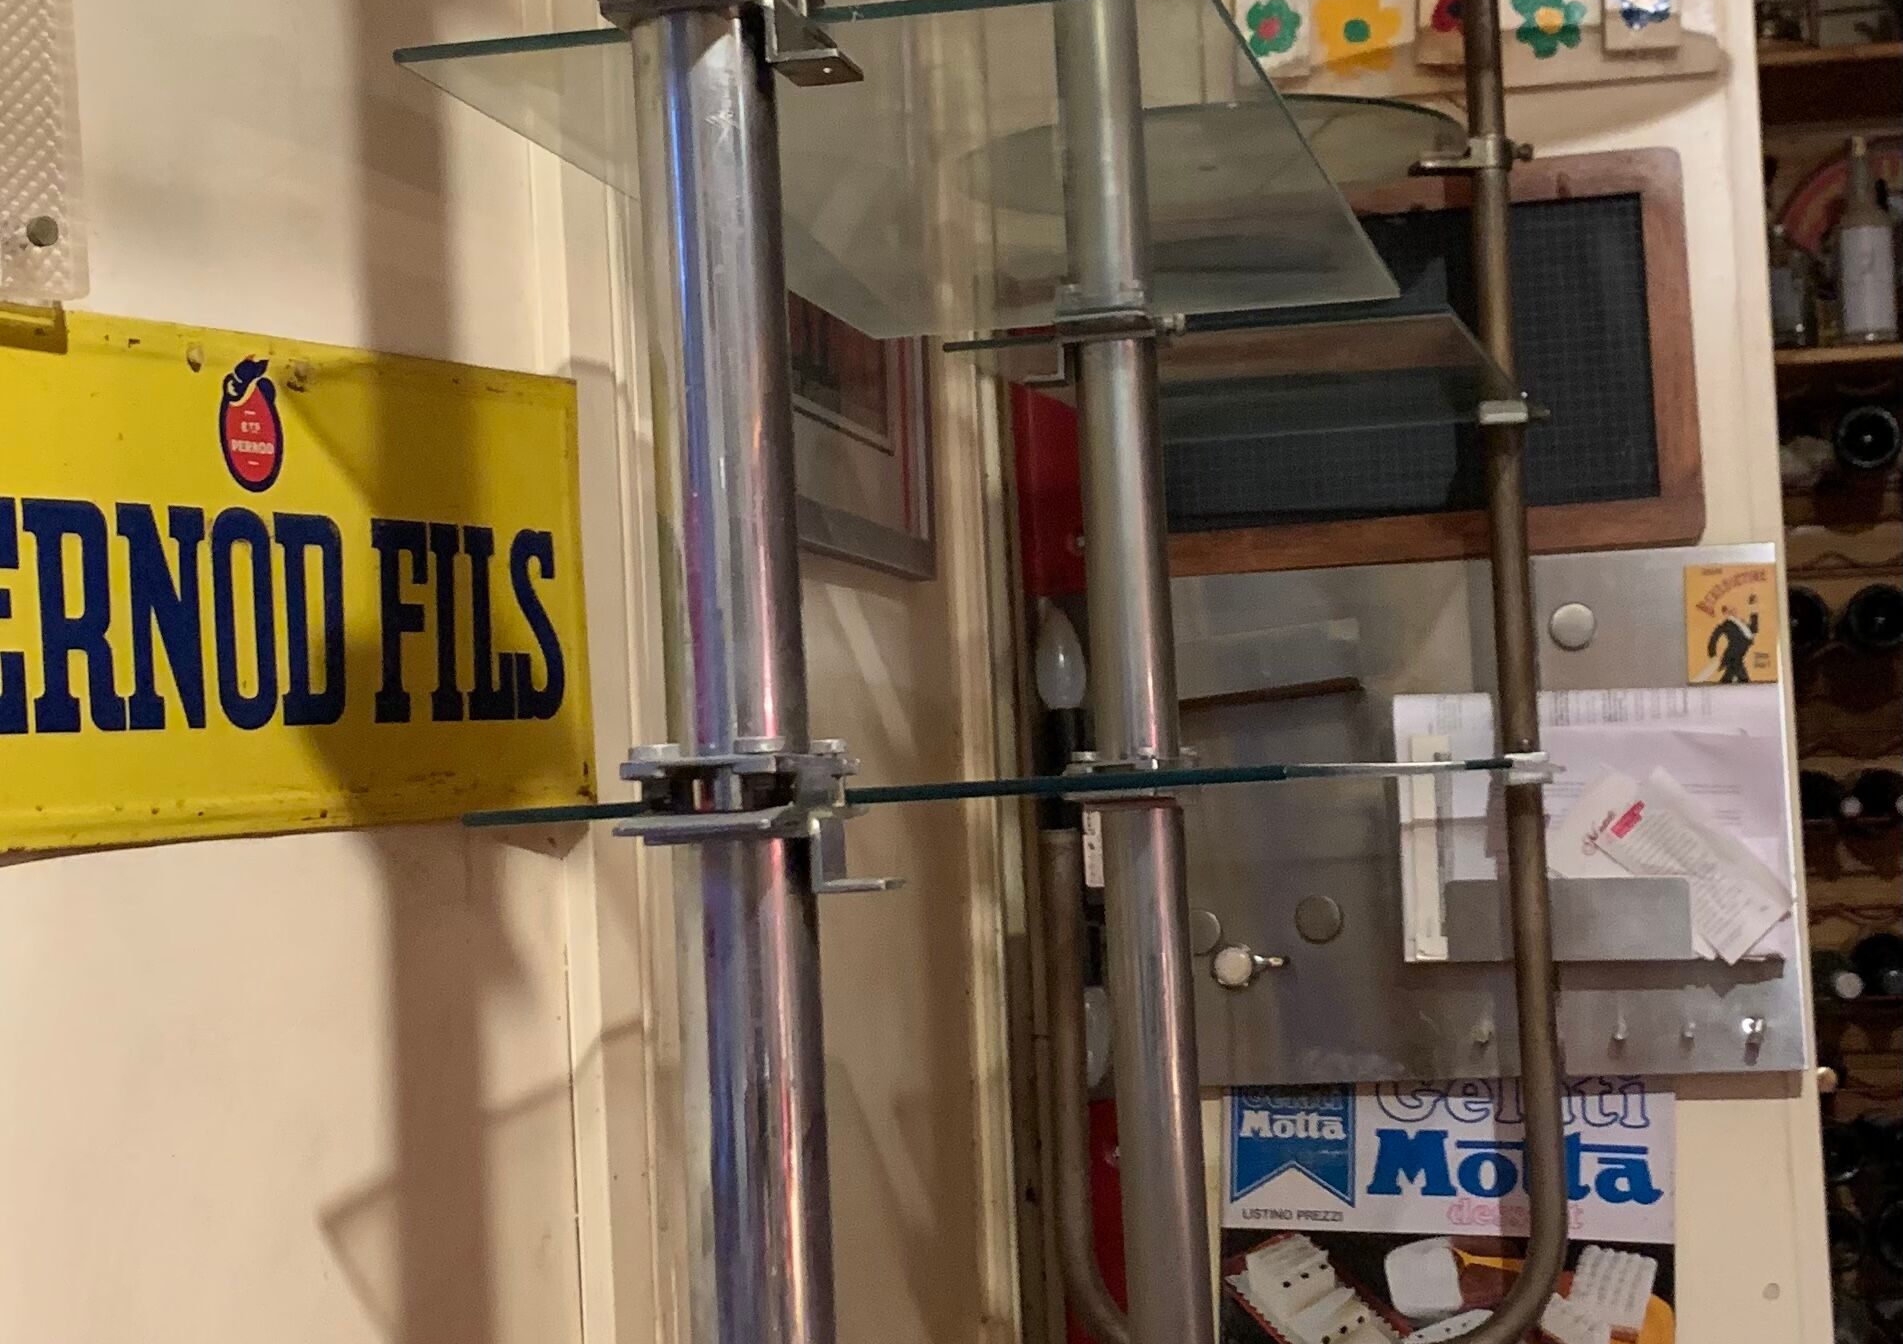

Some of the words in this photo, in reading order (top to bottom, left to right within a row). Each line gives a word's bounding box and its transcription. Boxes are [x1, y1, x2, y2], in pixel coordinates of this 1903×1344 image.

[371, 517, 565, 723] FILS
[1239, 1109, 1347, 1140] Motta
[1242, 1208, 1292, 1221] LISTINO
[1296, 1210, 1344, 1222] PREZZI
